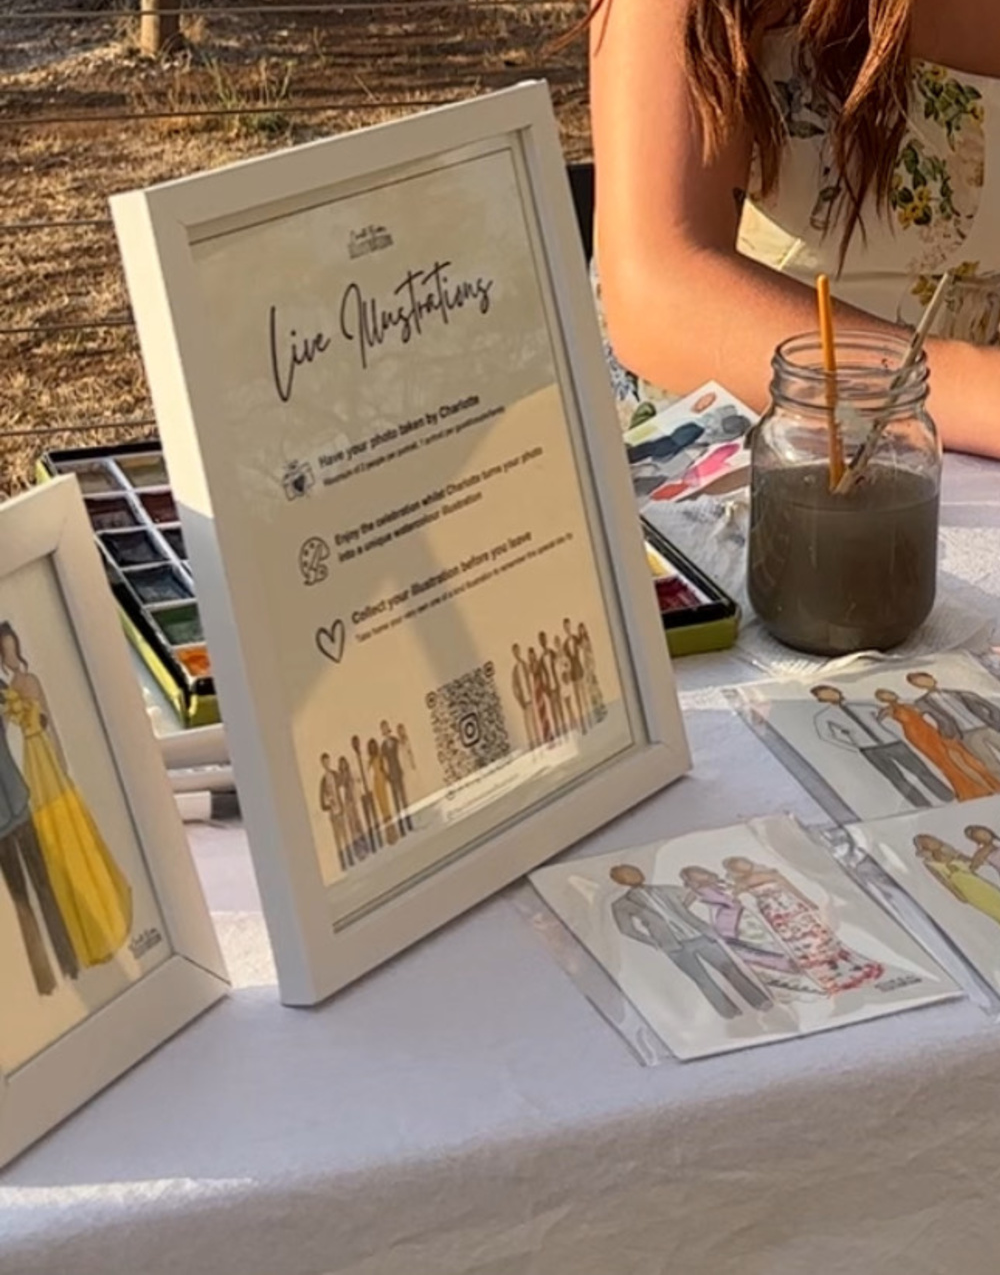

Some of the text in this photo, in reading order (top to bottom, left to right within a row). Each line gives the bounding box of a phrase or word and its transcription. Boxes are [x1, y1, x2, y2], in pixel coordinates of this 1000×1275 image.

[269, 261, 493, 402] Live Illustrations
[318, 450, 344, 468] Have
[346, 441, 367, 461] your
[370, 429, 398, 449] photo
[399, 417, 425, 436] taken
[425, 413, 438, 425] by
[439, 395, 479, 419] Charlotte
[334, 446, 543, 547] Enjoy the celebration whilst Charlotte turns your photo
[339, 549, 356, 562] into
[364, 533, 392, 552] unique
[441, 491, 482, 516] illustration
[351, 531, 532, 625] Collect your illustration before you leave
